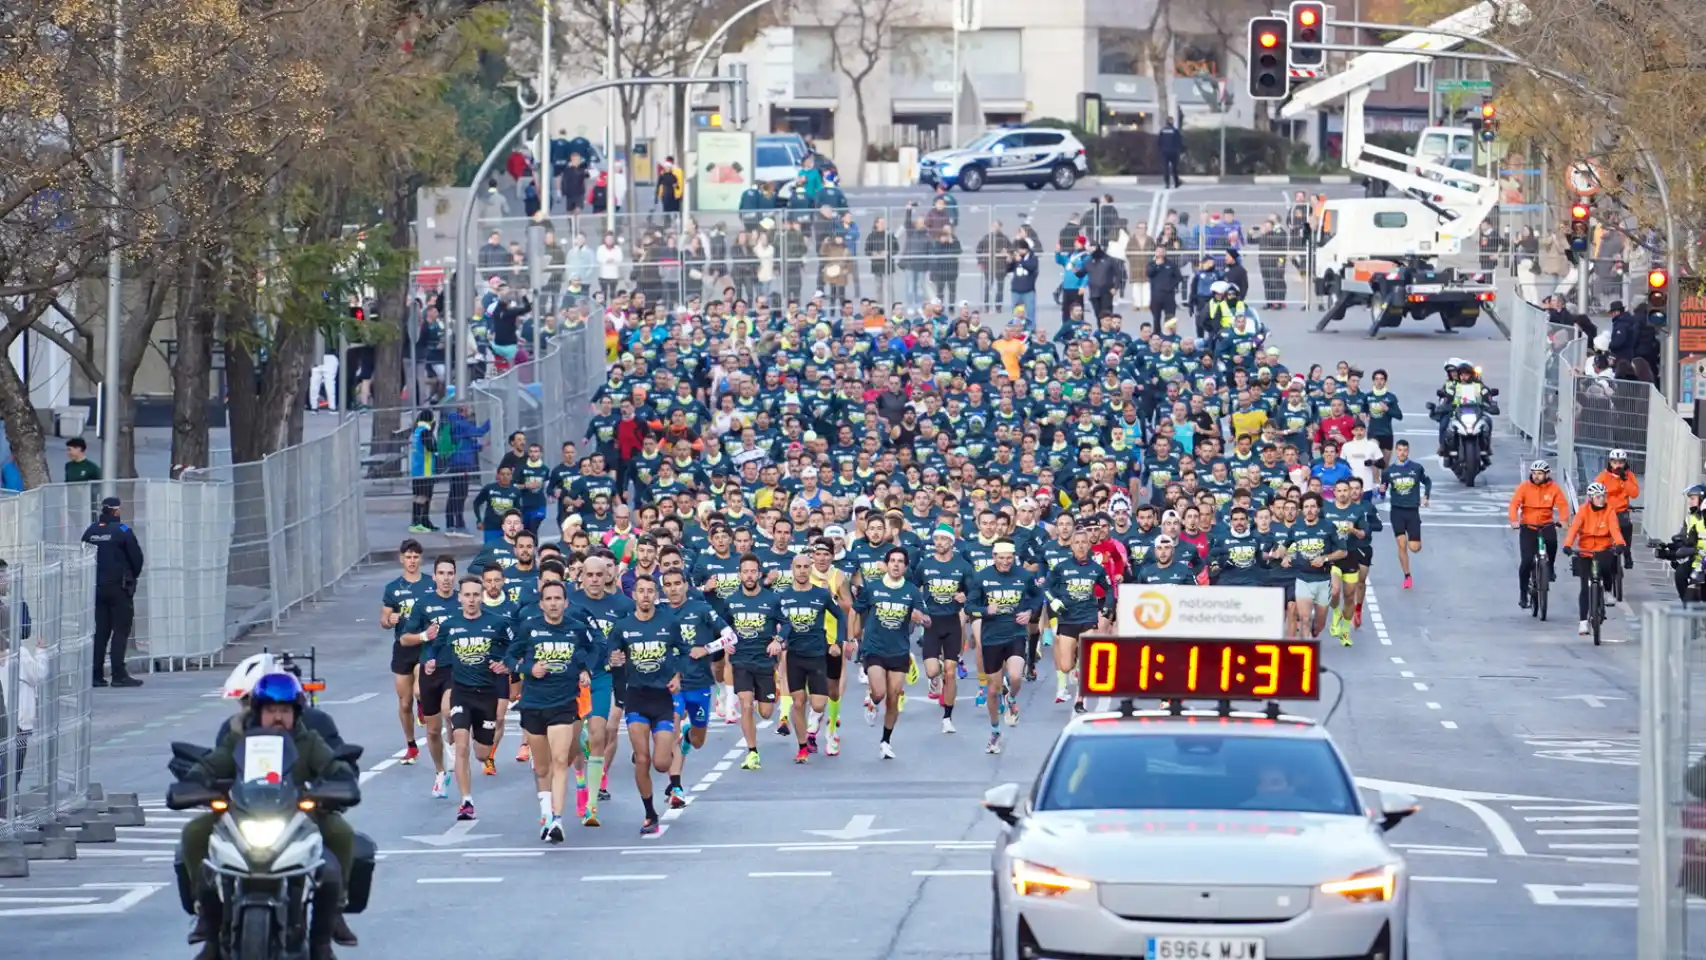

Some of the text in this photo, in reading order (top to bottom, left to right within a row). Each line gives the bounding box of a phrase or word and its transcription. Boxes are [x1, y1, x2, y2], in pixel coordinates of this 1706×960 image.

[1179, 598, 1242, 609] nationale
[1179, 611, 1264, 624] nederlanden
[1088, 642, 1313, 694] 01:11:37
[1160, 940, 1211, 959] 6964
